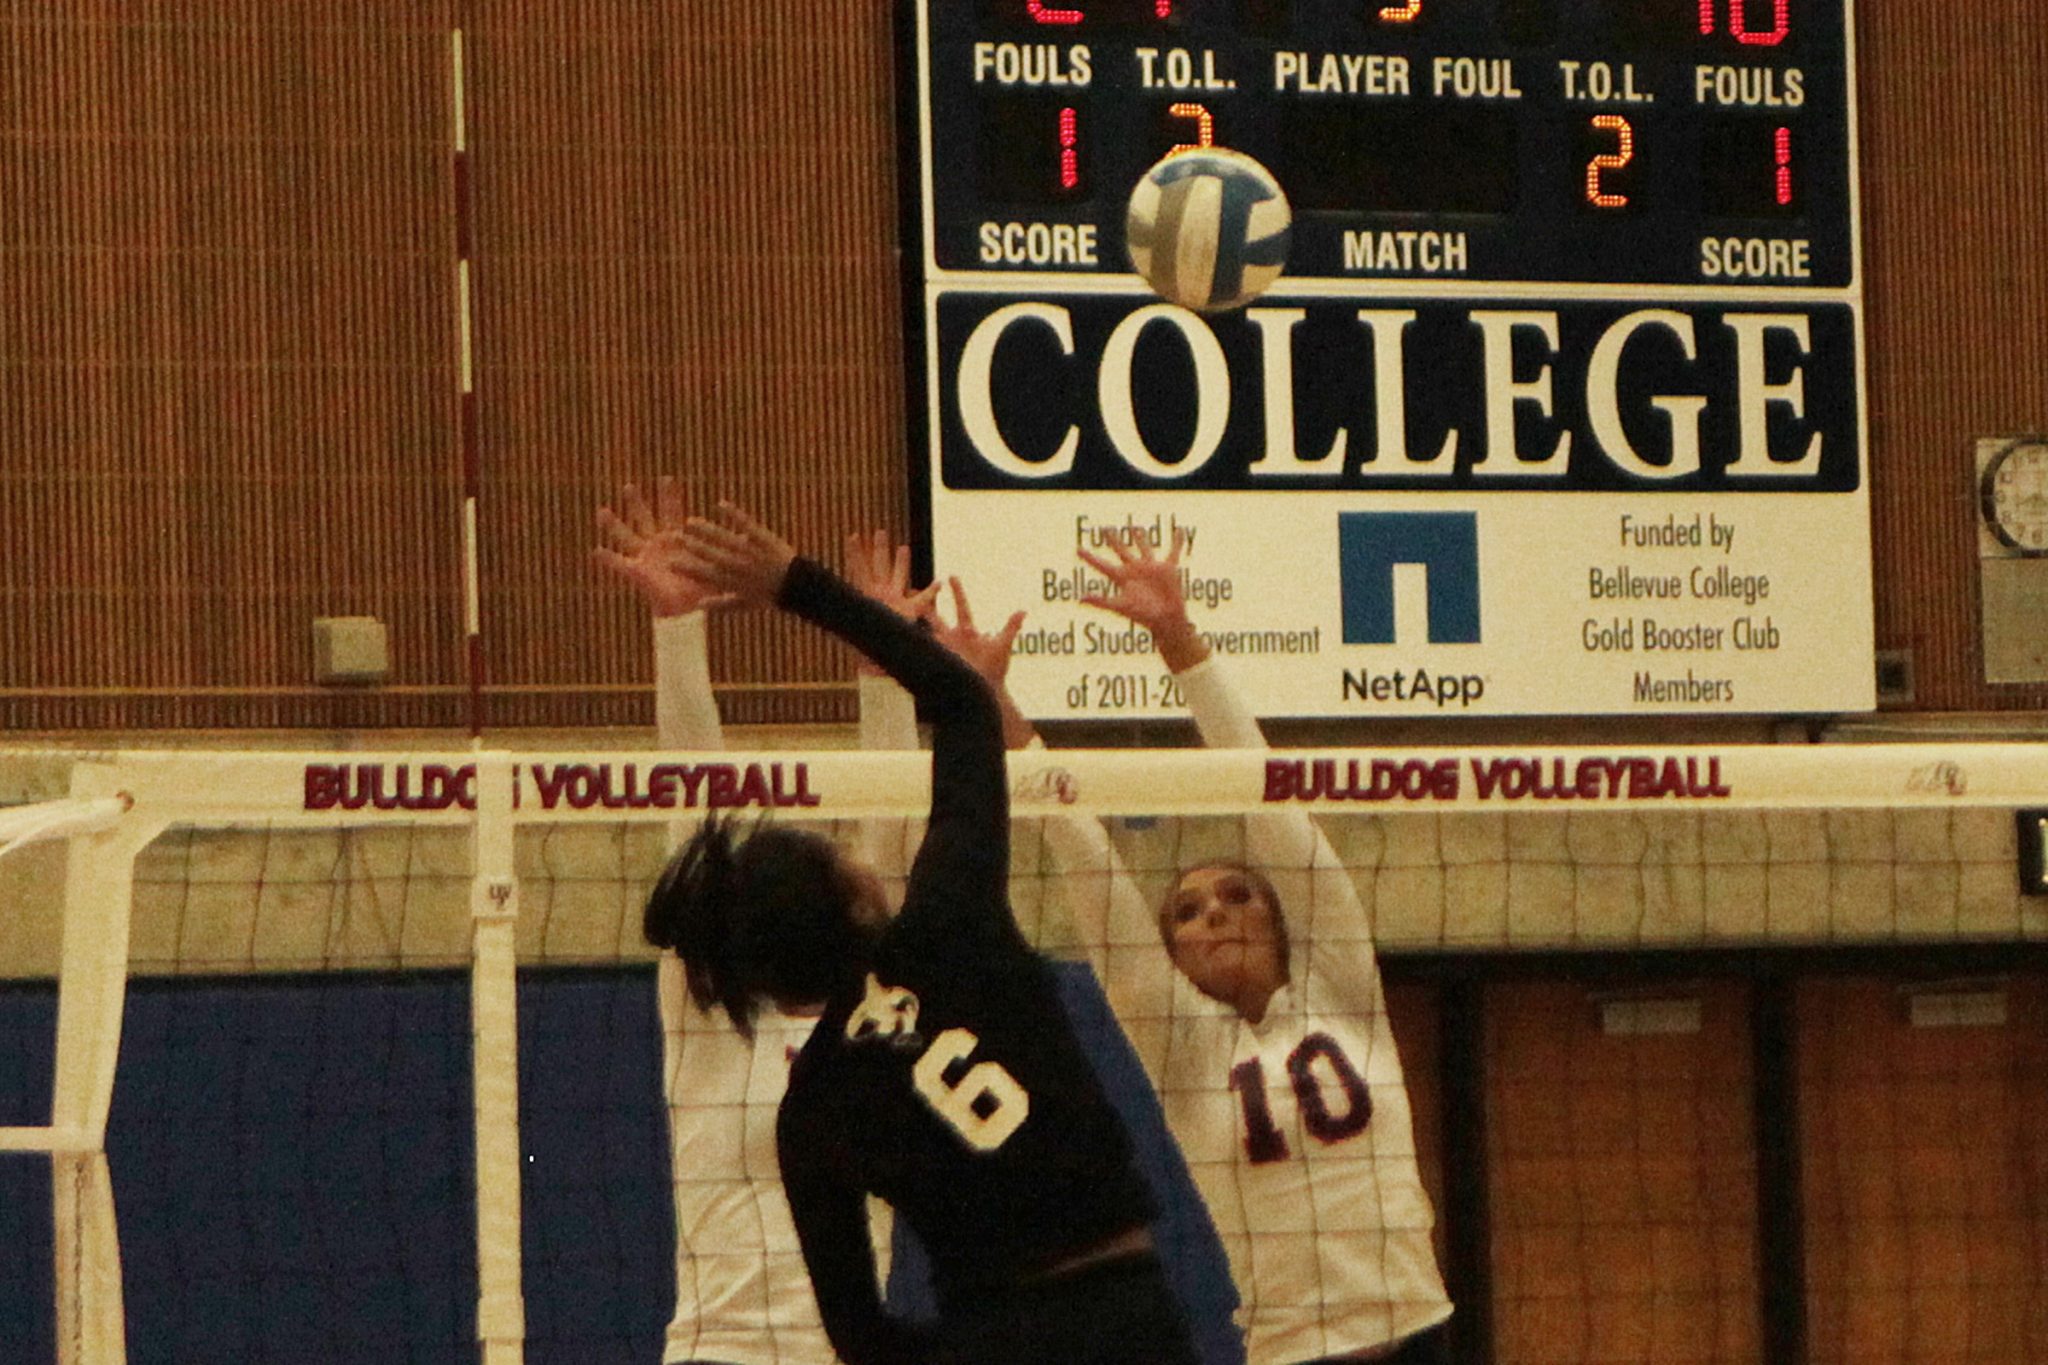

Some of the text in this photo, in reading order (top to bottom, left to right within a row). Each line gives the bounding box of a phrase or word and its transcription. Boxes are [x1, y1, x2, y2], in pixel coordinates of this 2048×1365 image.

[974, 42, 1092, 87] FOULS
[1135, 48, 1236, 91] T.O.L.
[1275, 51, 1522, 99] PLAYER FOUL
[1559, 60, 1654, 103] T.O.L.
[1696, 65, 1804, 107] FOULS
[1059, 107, 1078, 188] 1
[1586, 114, 1634, 207] 2
[1775, 127, 1792, 205] 1
[979, 222, 1098, 265] SCORE
[1343, 230, 1467, 272] MATCH
[1701, 237, 1811, 278] SCORE
[957, 302, 1823, 478] COLLEGE
[1620, 513, 1735, 555] Funded by
[1042, 566, 1120, 603] Bellev
[1589, 565, 1770, 606] Bellevue College
[1200, 624, 1321, 656] overnment
[1582, 616, 1780, 652] Gold Booster Club
[1066, 673, 1188, 710] of 2011-20
[1342, 669, 1484, 707] NetApp
[1633, 669, 1734, 703] Members
[304, 763, 821, 811] BULLDO VOLLEYBALL
[1262, 757, 1731, 803] BULLDOG VOLLEYBALL
[912, 1026, 1030, 1150] 6
[1228, 1032, 1373, 1165] 10
